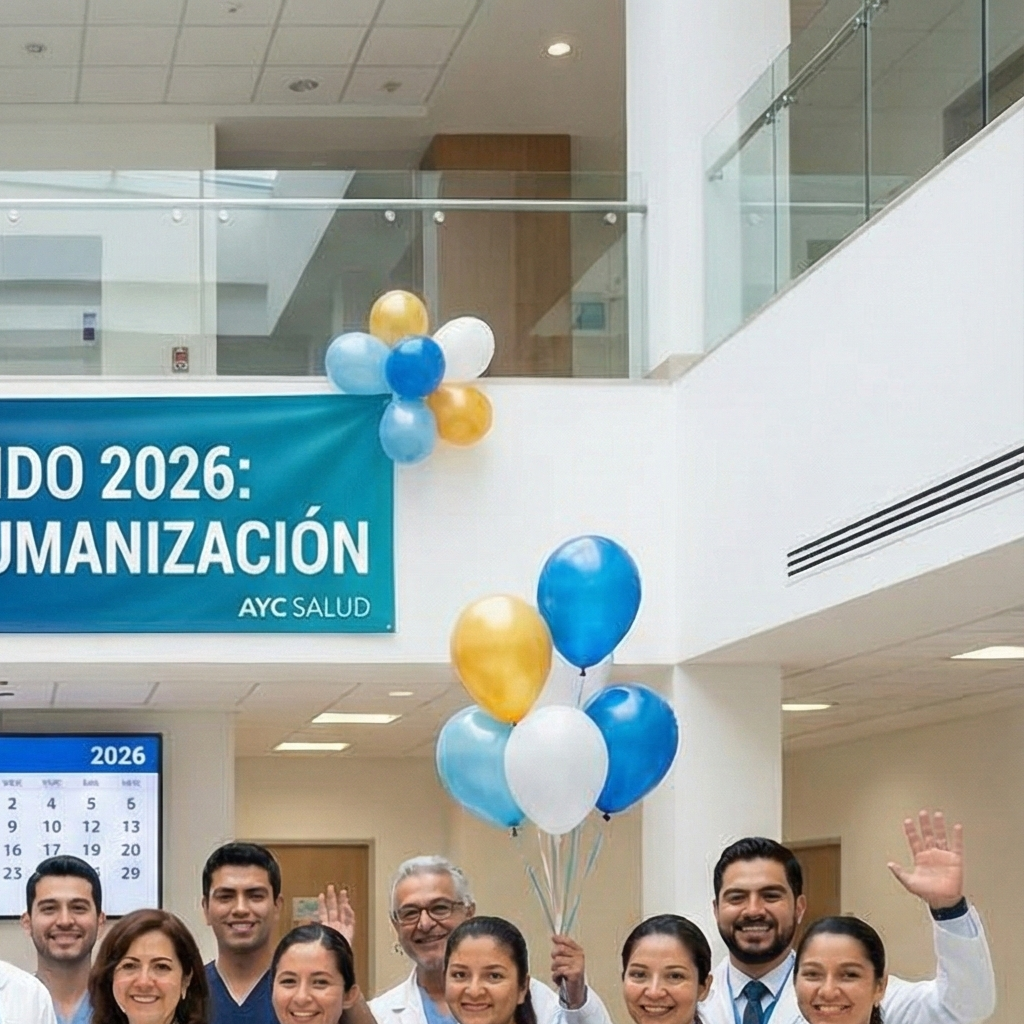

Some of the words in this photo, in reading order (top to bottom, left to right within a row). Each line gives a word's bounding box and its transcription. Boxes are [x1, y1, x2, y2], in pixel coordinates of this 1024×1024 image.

[101, 446, 250, 499] 2026:
[238, 597, 287, 617] AYC
[292, 597, 371, 618] SALUD
[90, 745, 146, 765] 2026
[7, 797, 17, 810] 2
[46, 797, 57, 810] 4
[87, 797, 96, 810] 5
[7, 820, 18, 834] 9
[43, 820, 62, 833] 10
[82, 820, 101, 833] 12
[123, 820, 141, 833] 13
[4, 844, 22, 857] 16
[43, 844, 61, 856] 17
[82, 844, 101, 857] 19
[121, 844, 141, 857] 20
[3, 866, 23, 880] 23
[121, 866, 141, 880] 29
